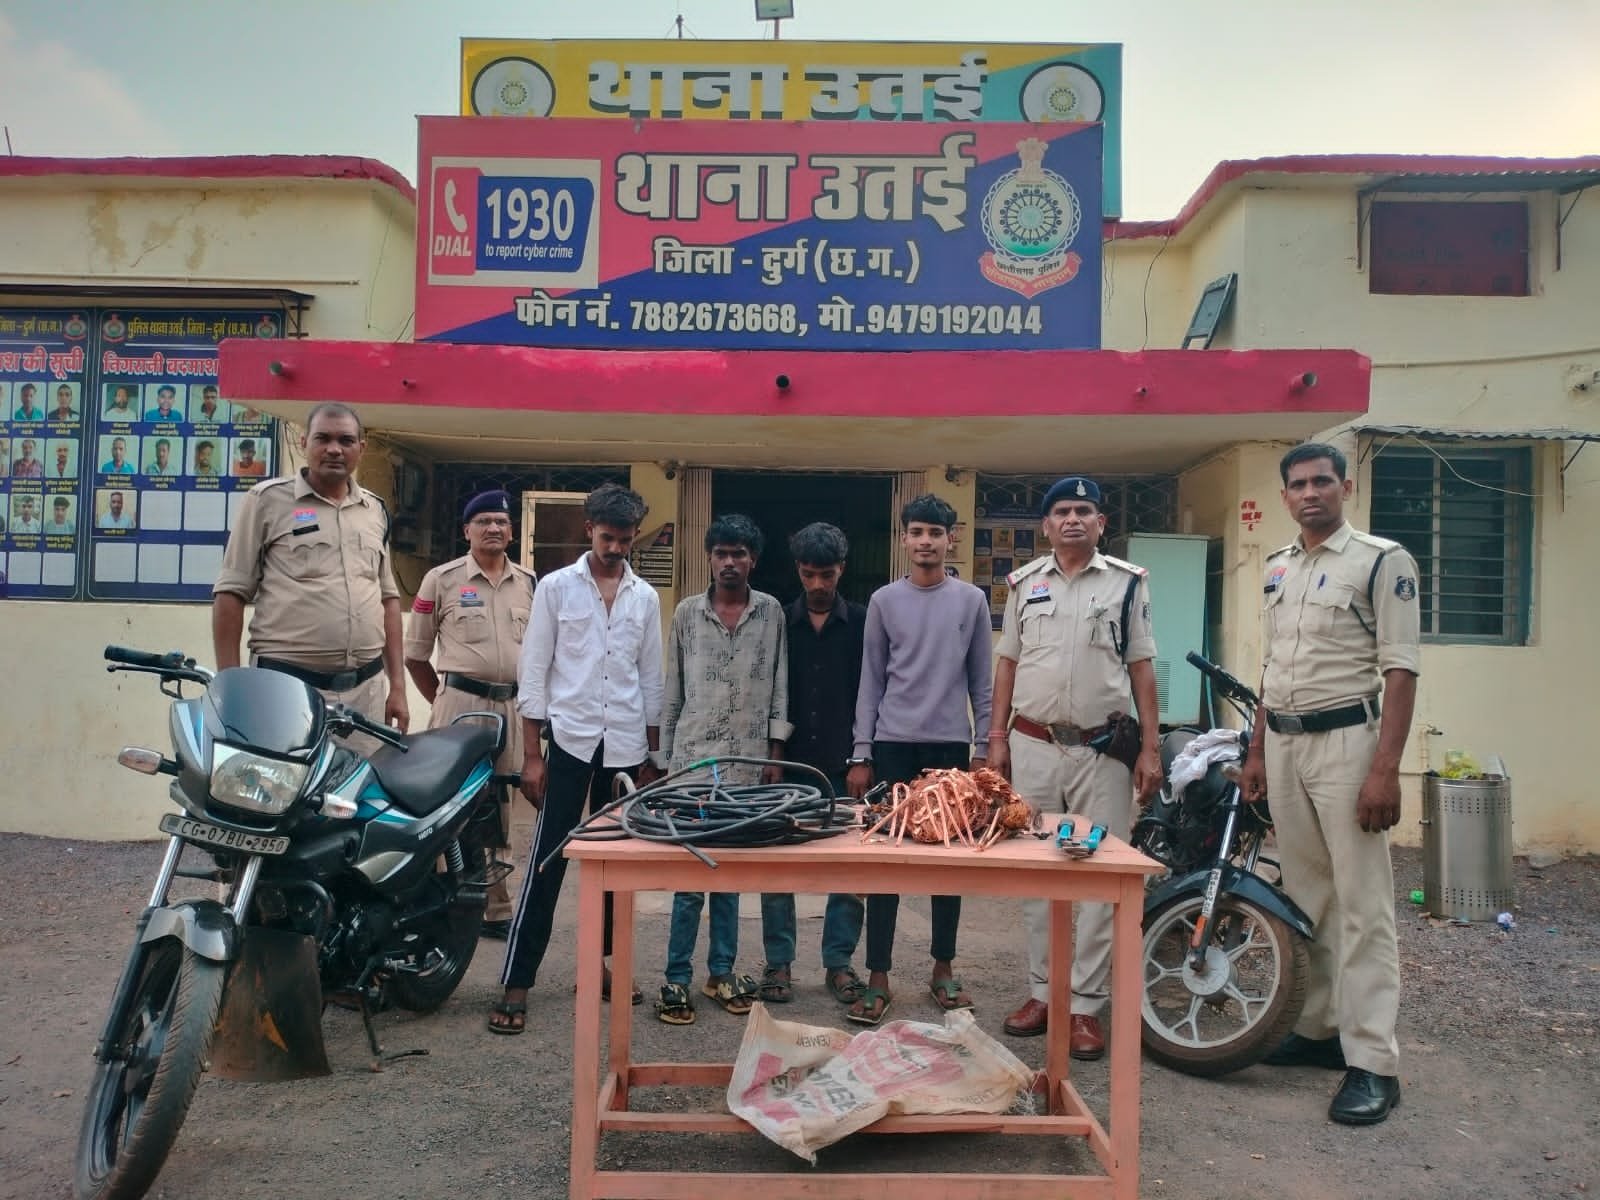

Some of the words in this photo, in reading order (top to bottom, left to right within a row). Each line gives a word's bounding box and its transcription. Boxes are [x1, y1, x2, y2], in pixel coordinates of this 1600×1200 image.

[588, 60, 789, 120] थाना
[804, 51, 988, 121] उतई
[614, 152, 799, 222] थाना
[808, 131, 977, 232] उतई
[486, 187, 575, 241] 1930
[434, 235, 472, 257] DIAL
[485, 243, 495, 257] to
[496, 244, 523, 260] report
[523, 243, 548, 261] cyber
[549, 245, 574, 259] crime
[653, 237, 735, 275] जिला
[761, 238, 809, 286] दुर्ग
[515, 290, 580, 328] फोन
[23, 345, 47, 373] की
[49, 345, 85, 380] सूची
[103, 350, 164, 376] निगरानी
